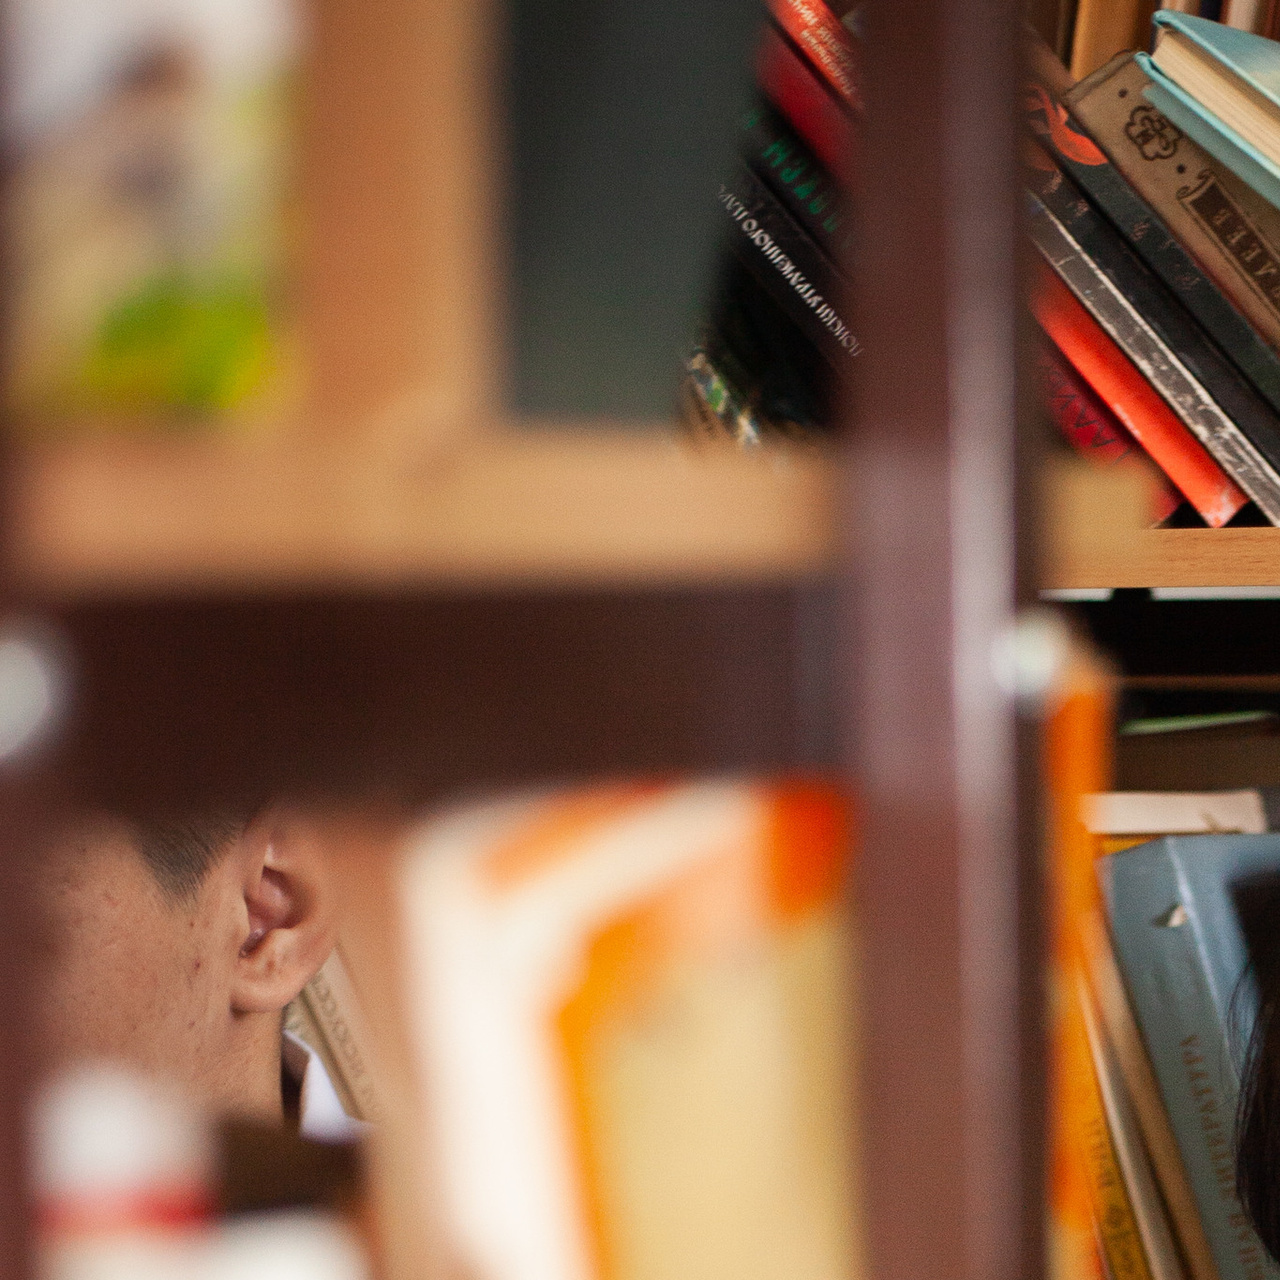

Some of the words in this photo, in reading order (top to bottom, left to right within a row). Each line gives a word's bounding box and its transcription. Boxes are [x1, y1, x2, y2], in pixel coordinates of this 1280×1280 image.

[741, 218, 824, 308] УТРАЧЕННОГО
[816, 303, 863, 357] ПОИСКИ
[1181, 1034, 1236, 1199] ЛИТЕРАТУРА
